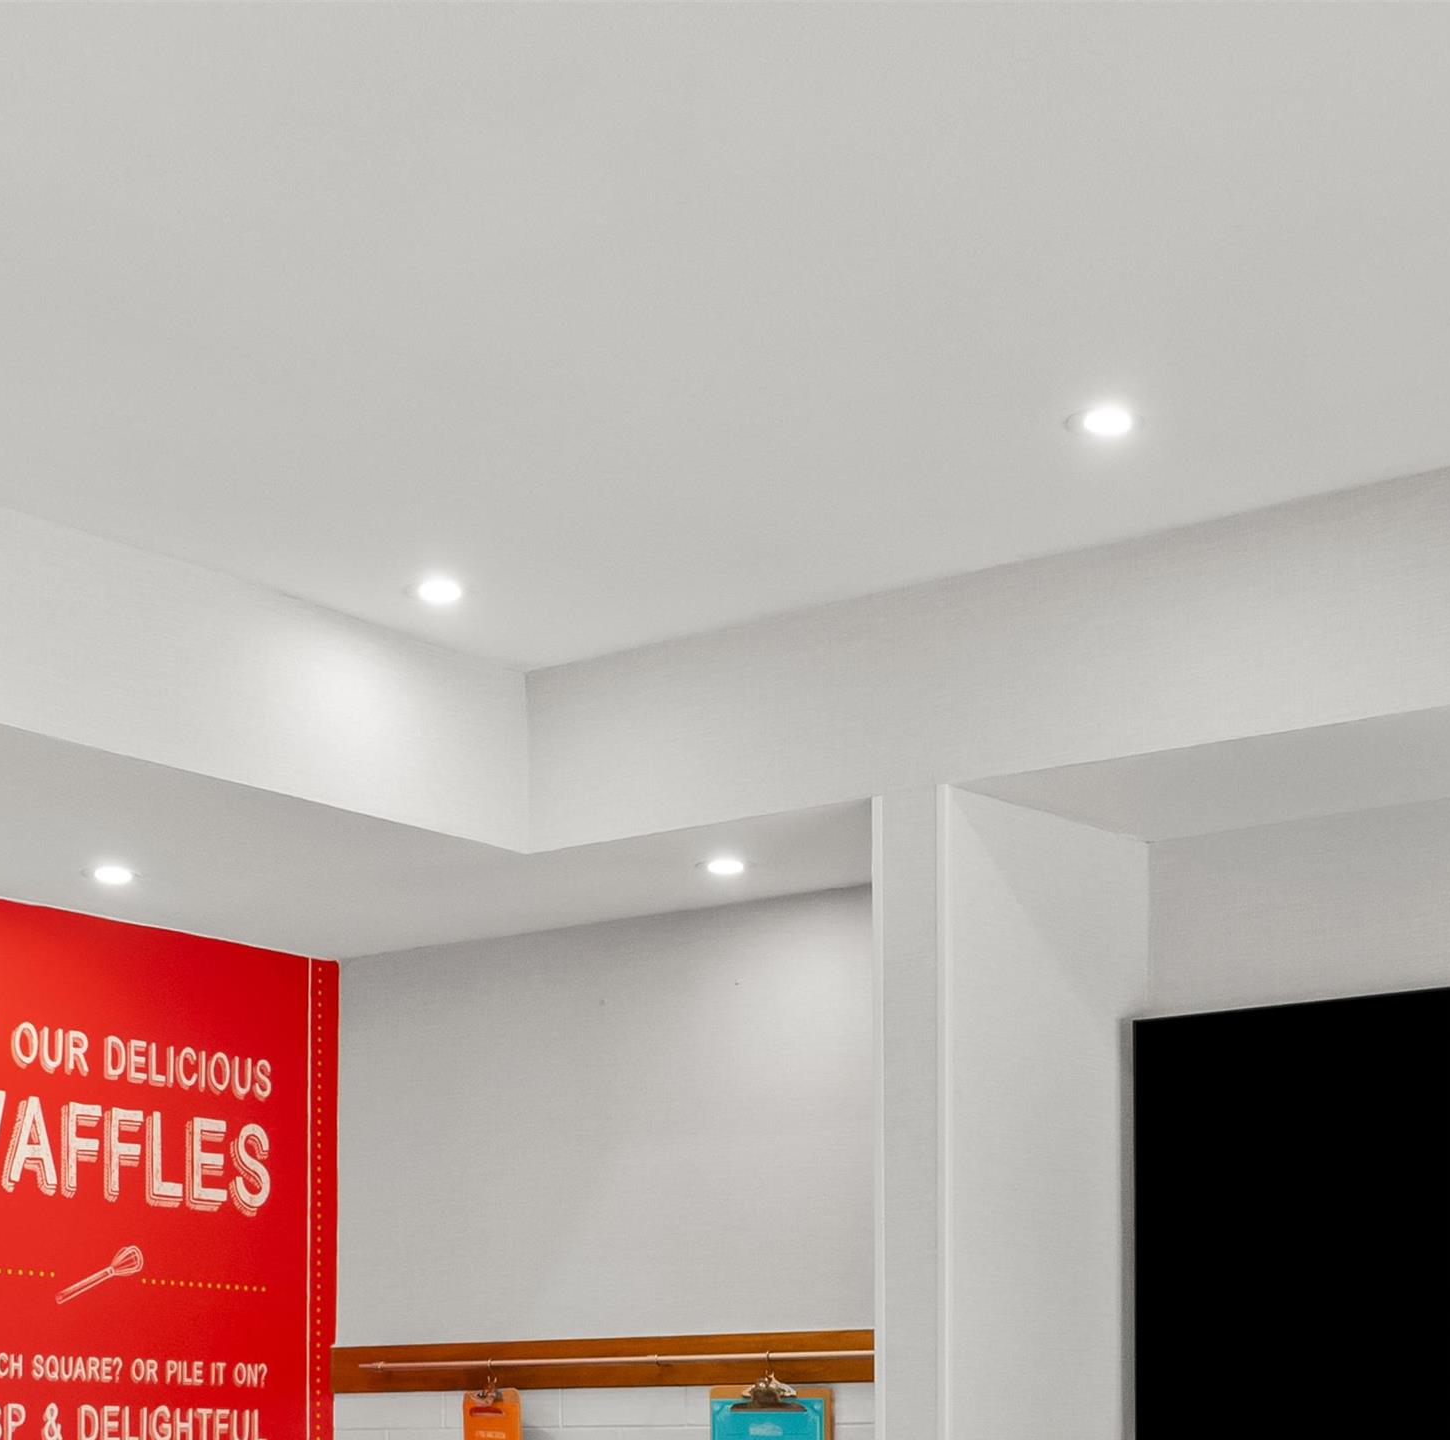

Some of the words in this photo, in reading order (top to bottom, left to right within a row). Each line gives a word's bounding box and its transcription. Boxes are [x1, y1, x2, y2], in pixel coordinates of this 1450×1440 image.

[11, 1021, 89, 1076] OUR
[103, 1035, 272, 1101] DELICIOUS
[31, 1354, 123, 1383] SQUARE?
[130, 1358, 159, 1385] OR
[165, 1360, 204, 1386] PILE
[210, 1362, 226, 1386] IT
[233, 1362, 268, 1388] ON?
